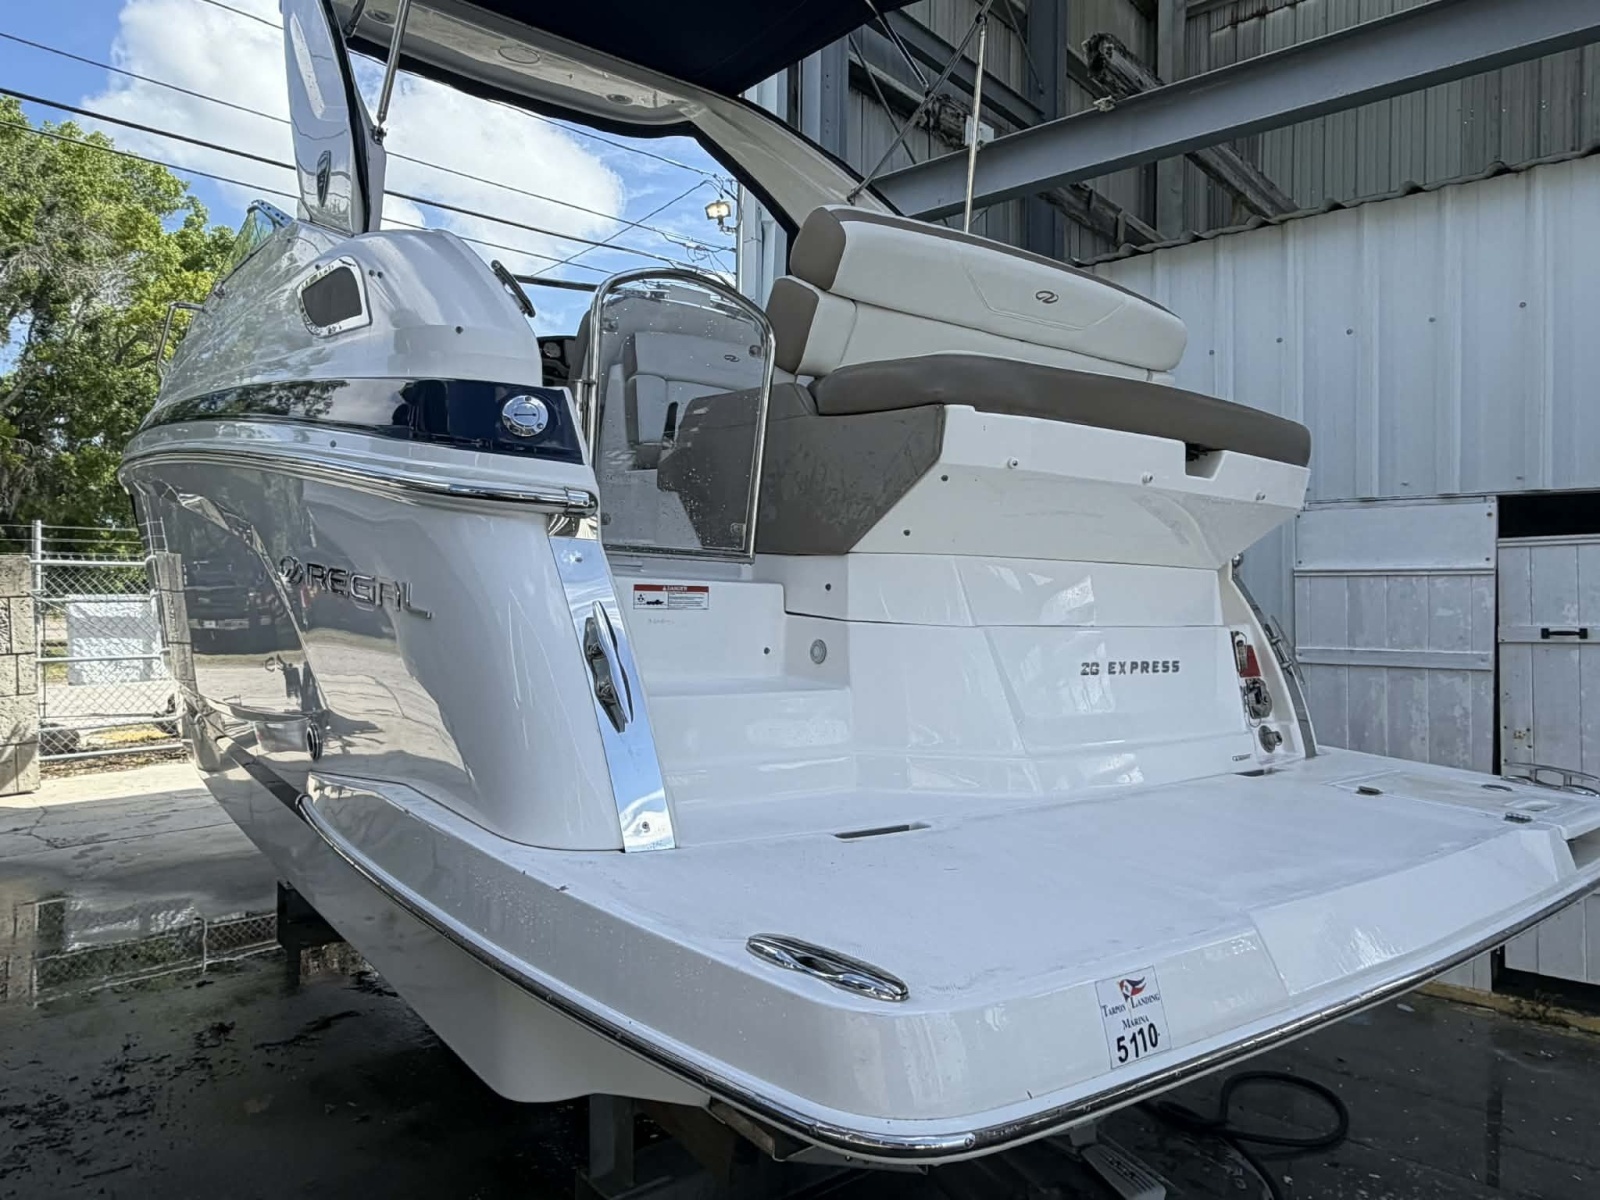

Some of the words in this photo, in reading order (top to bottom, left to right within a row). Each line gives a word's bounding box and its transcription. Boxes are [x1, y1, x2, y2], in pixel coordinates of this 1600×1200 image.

[306, 562, 433, 621] REGAL
[1107, 660, 1180, 675] EXPRESS
[1116, 1022, 1159, 1063] 5110
